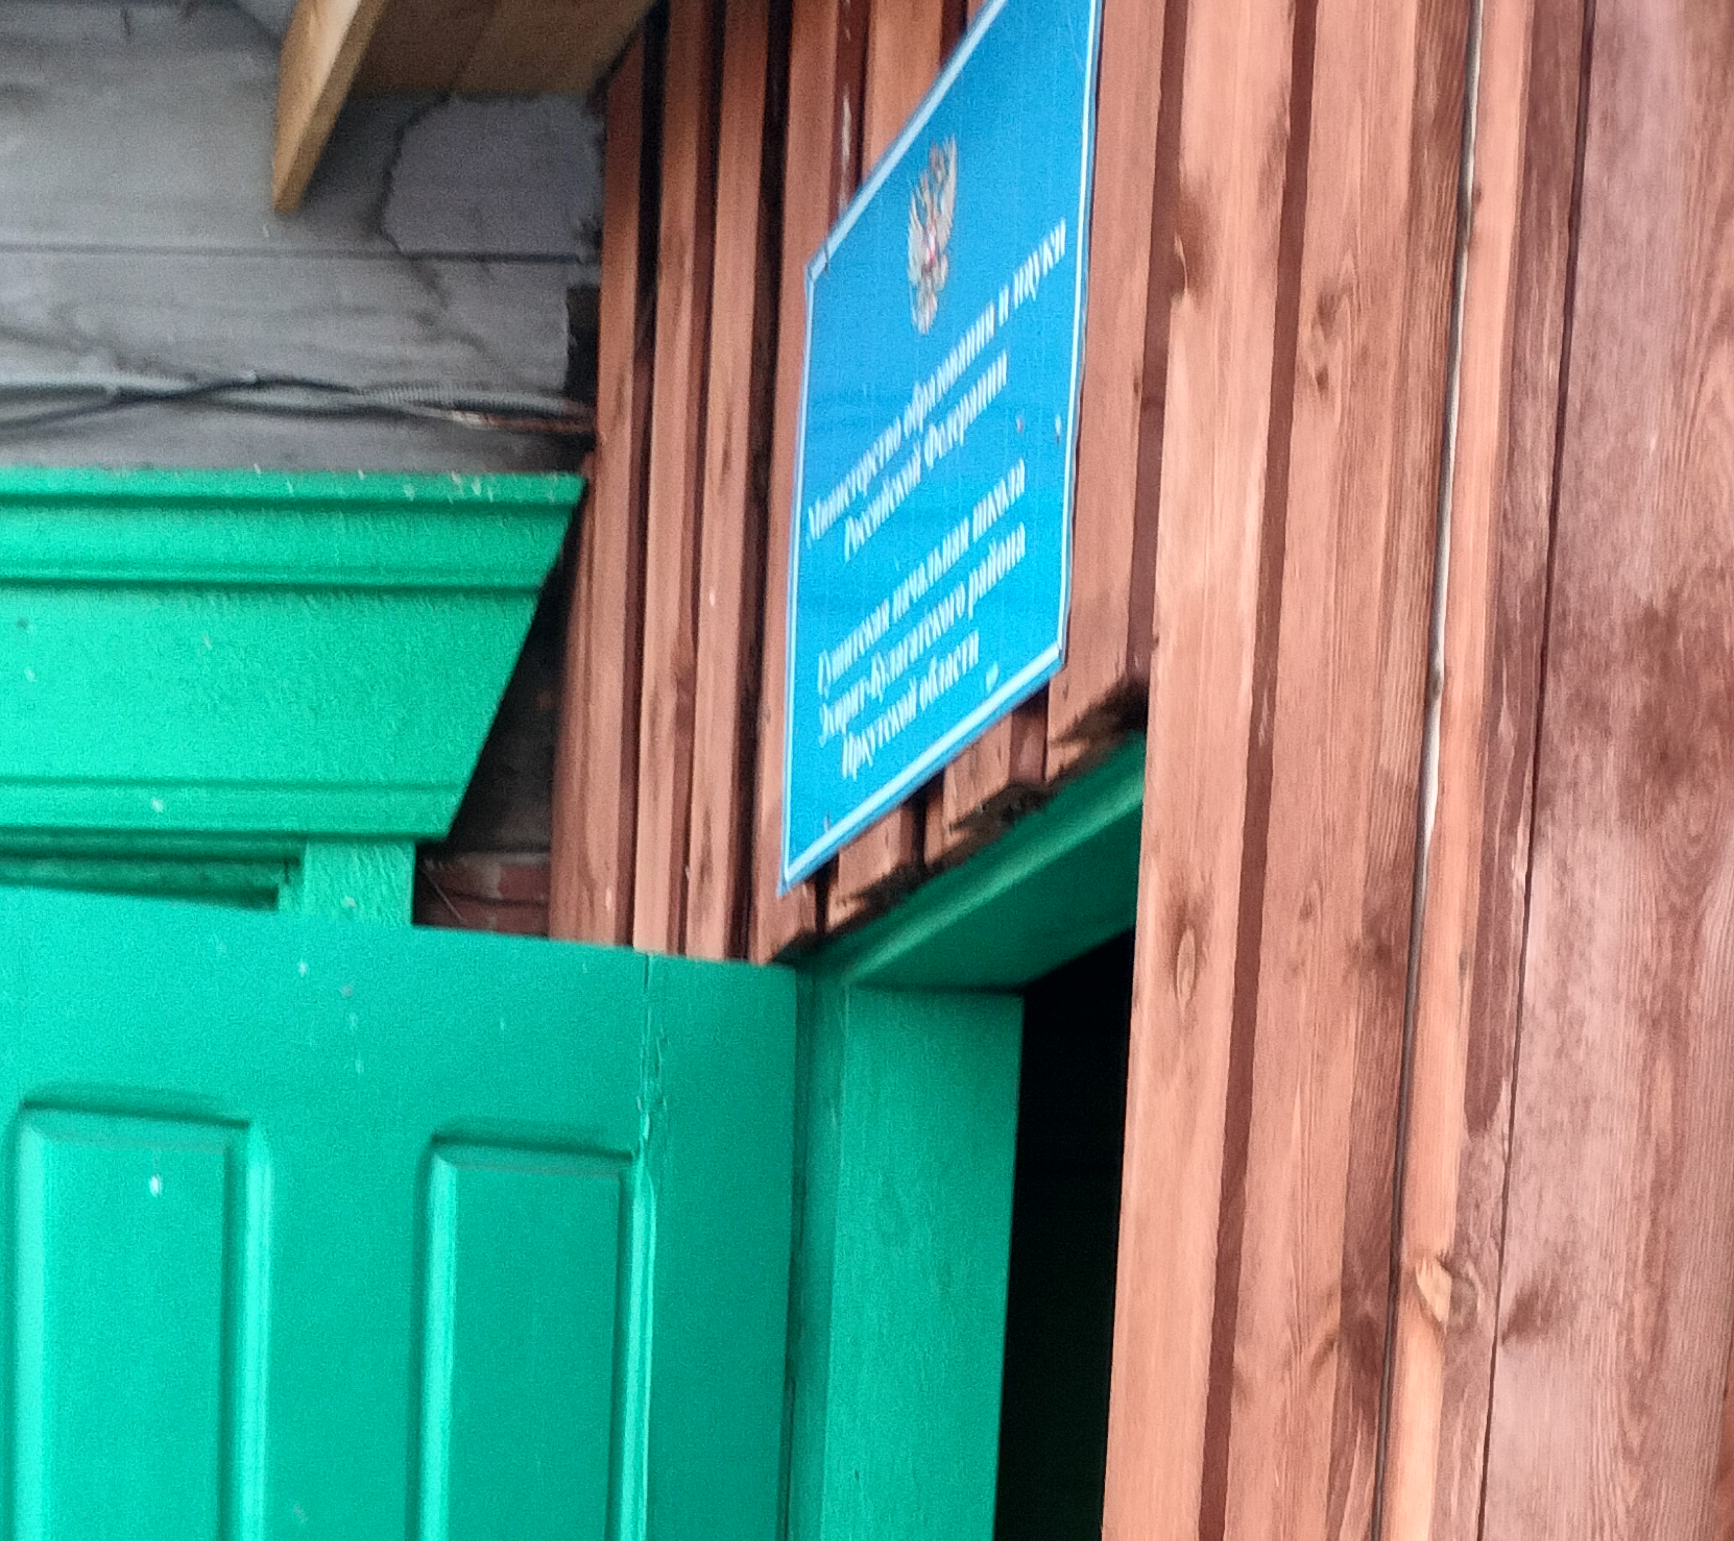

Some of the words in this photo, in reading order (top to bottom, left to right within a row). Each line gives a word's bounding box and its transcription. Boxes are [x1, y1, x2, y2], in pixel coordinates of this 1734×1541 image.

[807, 415, 902, 549] Министерство
[903, 300, 995, 439] образования
[999, 284, 1010, 328] и
[1013, 216, 1067, 310] науки
[844, 438, 921, 563] Российской
[925, 347, 1008, 471] Федерации
[892, 516, 969, 623] начальная
[972, 457, 1026, 543] школа
[968, 521, 1026, 621] района
[841, 677, 917, 781] Иркутской
[919, 628, 980, 712] области
